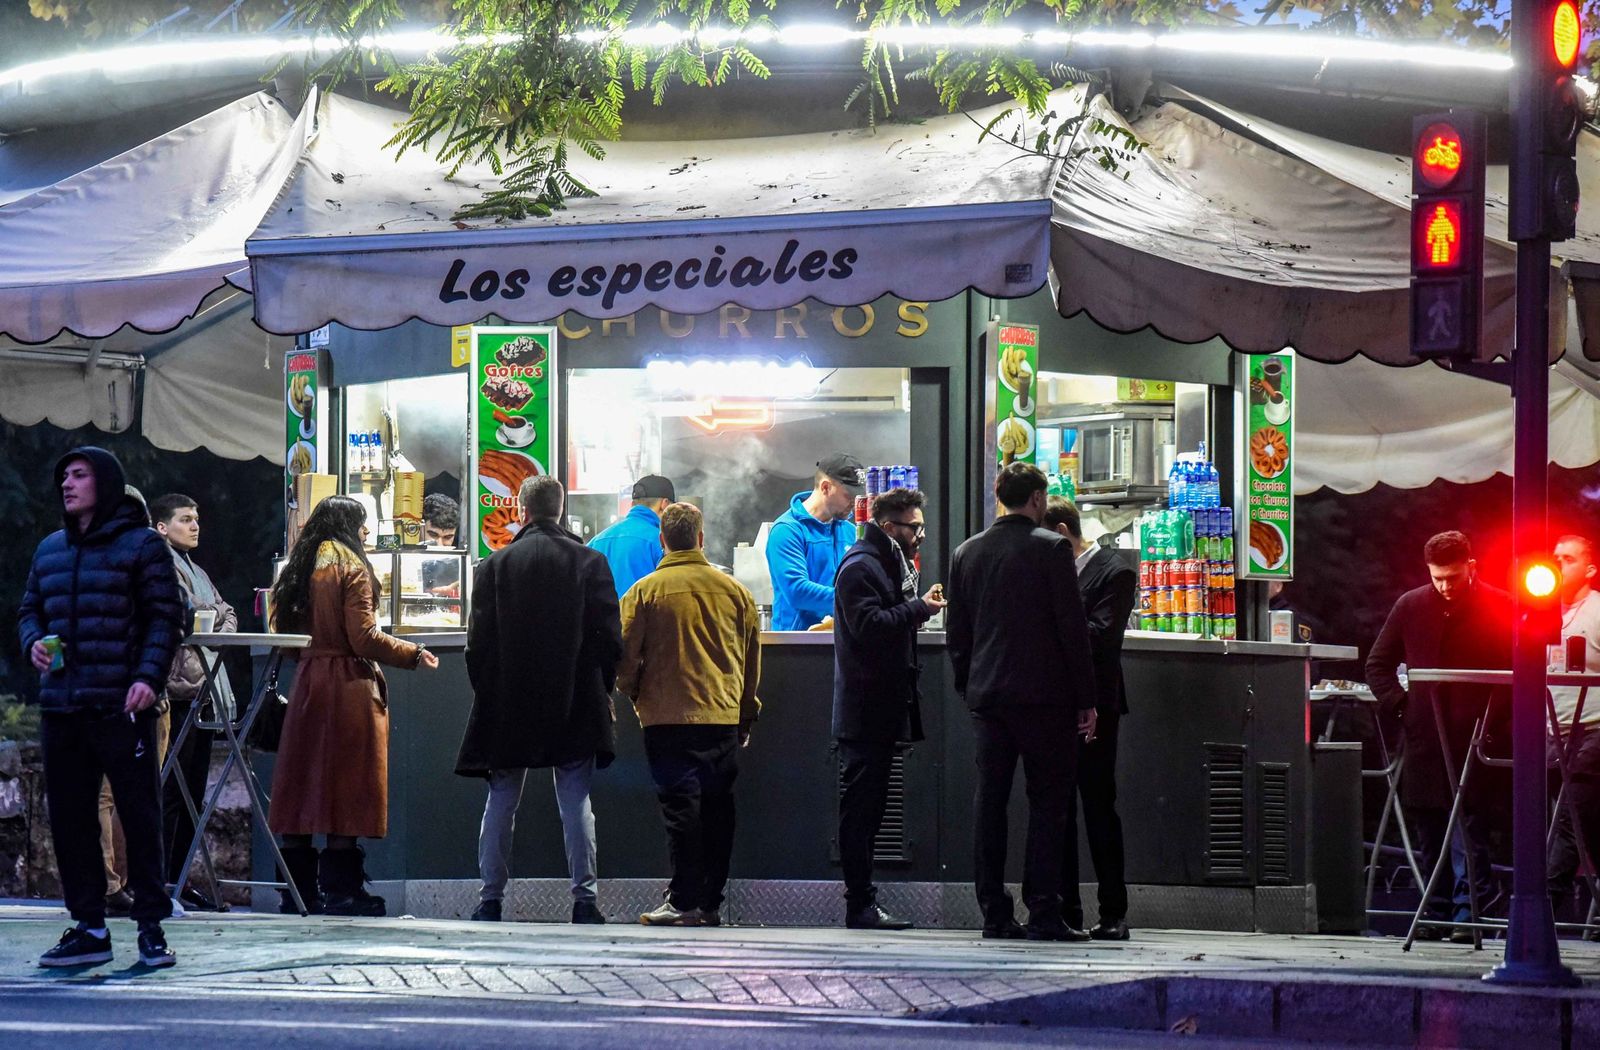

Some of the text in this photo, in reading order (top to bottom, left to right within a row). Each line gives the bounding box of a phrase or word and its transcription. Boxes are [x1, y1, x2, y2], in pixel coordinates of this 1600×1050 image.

[439, 239, 858, 309] Los especiales
[999, 327, 1036, 346] CHURROS
[484, 363, 543, 378] Gofres
[1252, 479, 1287, 492] Chocolate
[1250, 494, 1289, 506] con Churros
[1258, 507, 1289, 520] Churritos
